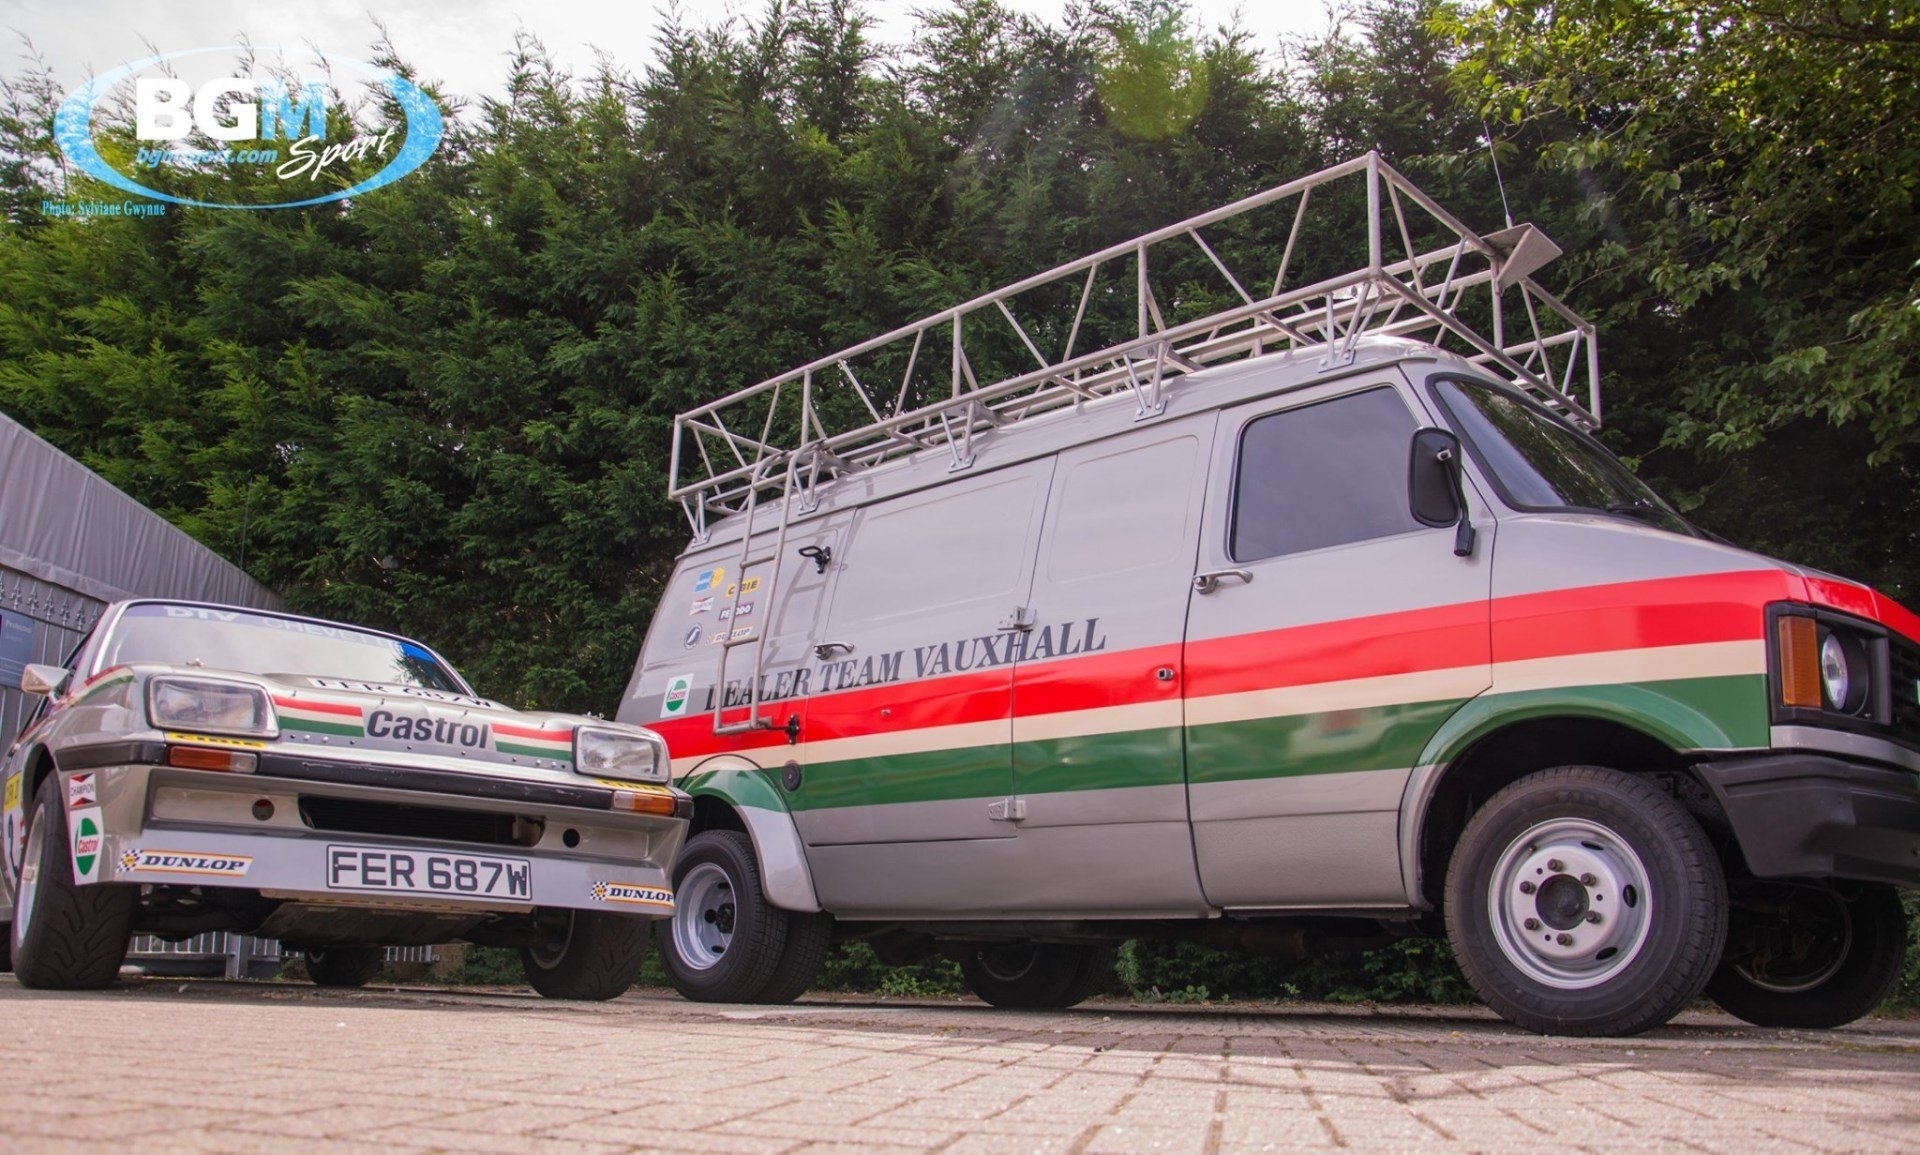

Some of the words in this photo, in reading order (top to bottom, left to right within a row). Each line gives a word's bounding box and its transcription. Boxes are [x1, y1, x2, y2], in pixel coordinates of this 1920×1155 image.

[728, 579, 759, 595] CBIE
[720, 604, 751, 619] FEODO
[715, 627, 750, 641] DULOP
[820, 651, 904, 692] TEAM
[912, 617, 1107, 678] VAUXHALL
[366, 709, 489, 749] Castrol
[142, 855, 245, 871] DUNLOP
[332, 851, 416, 888] FER
[427, 857, 528, 896] 687W
